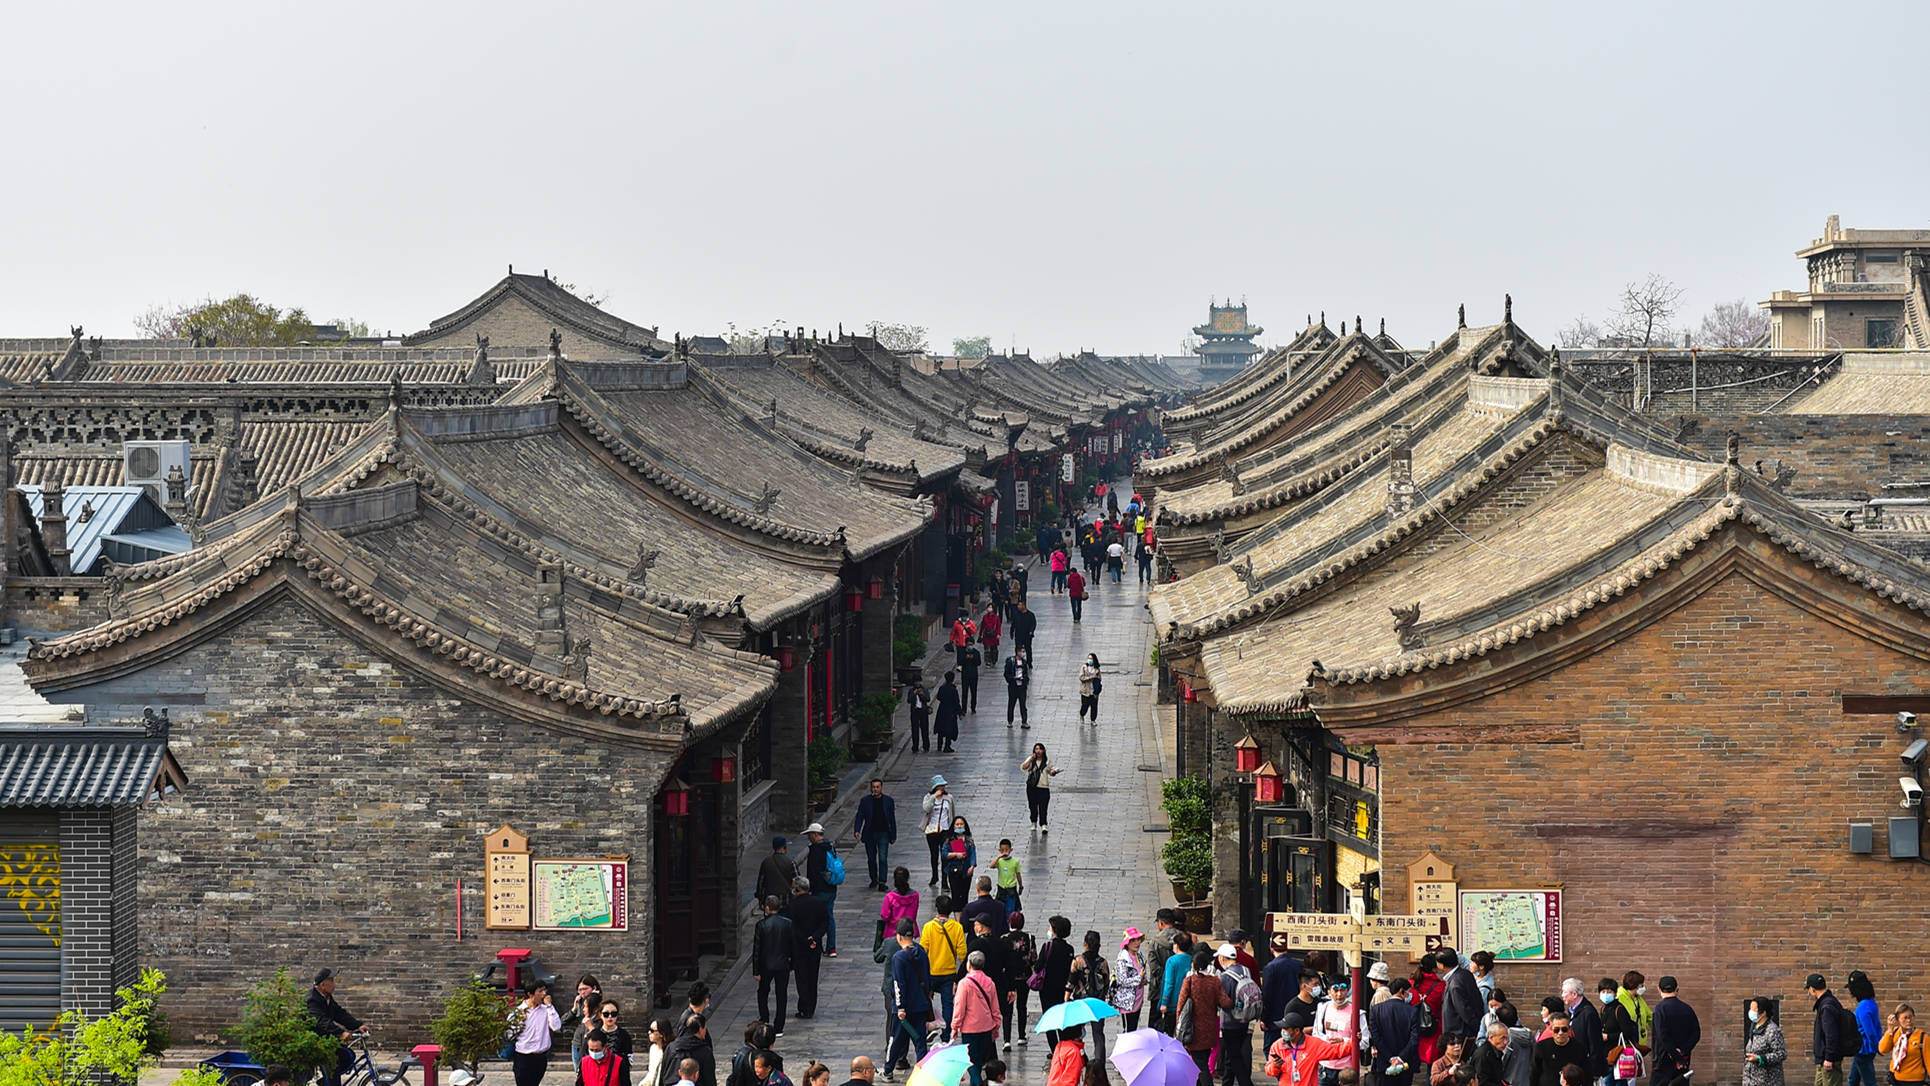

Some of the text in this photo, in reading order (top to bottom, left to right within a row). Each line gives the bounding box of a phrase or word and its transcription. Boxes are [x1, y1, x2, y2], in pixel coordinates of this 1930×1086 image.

[1287, 915, 1337, 925] 西南门头街
[1376, 917, 1427, 927] 东南门头街
